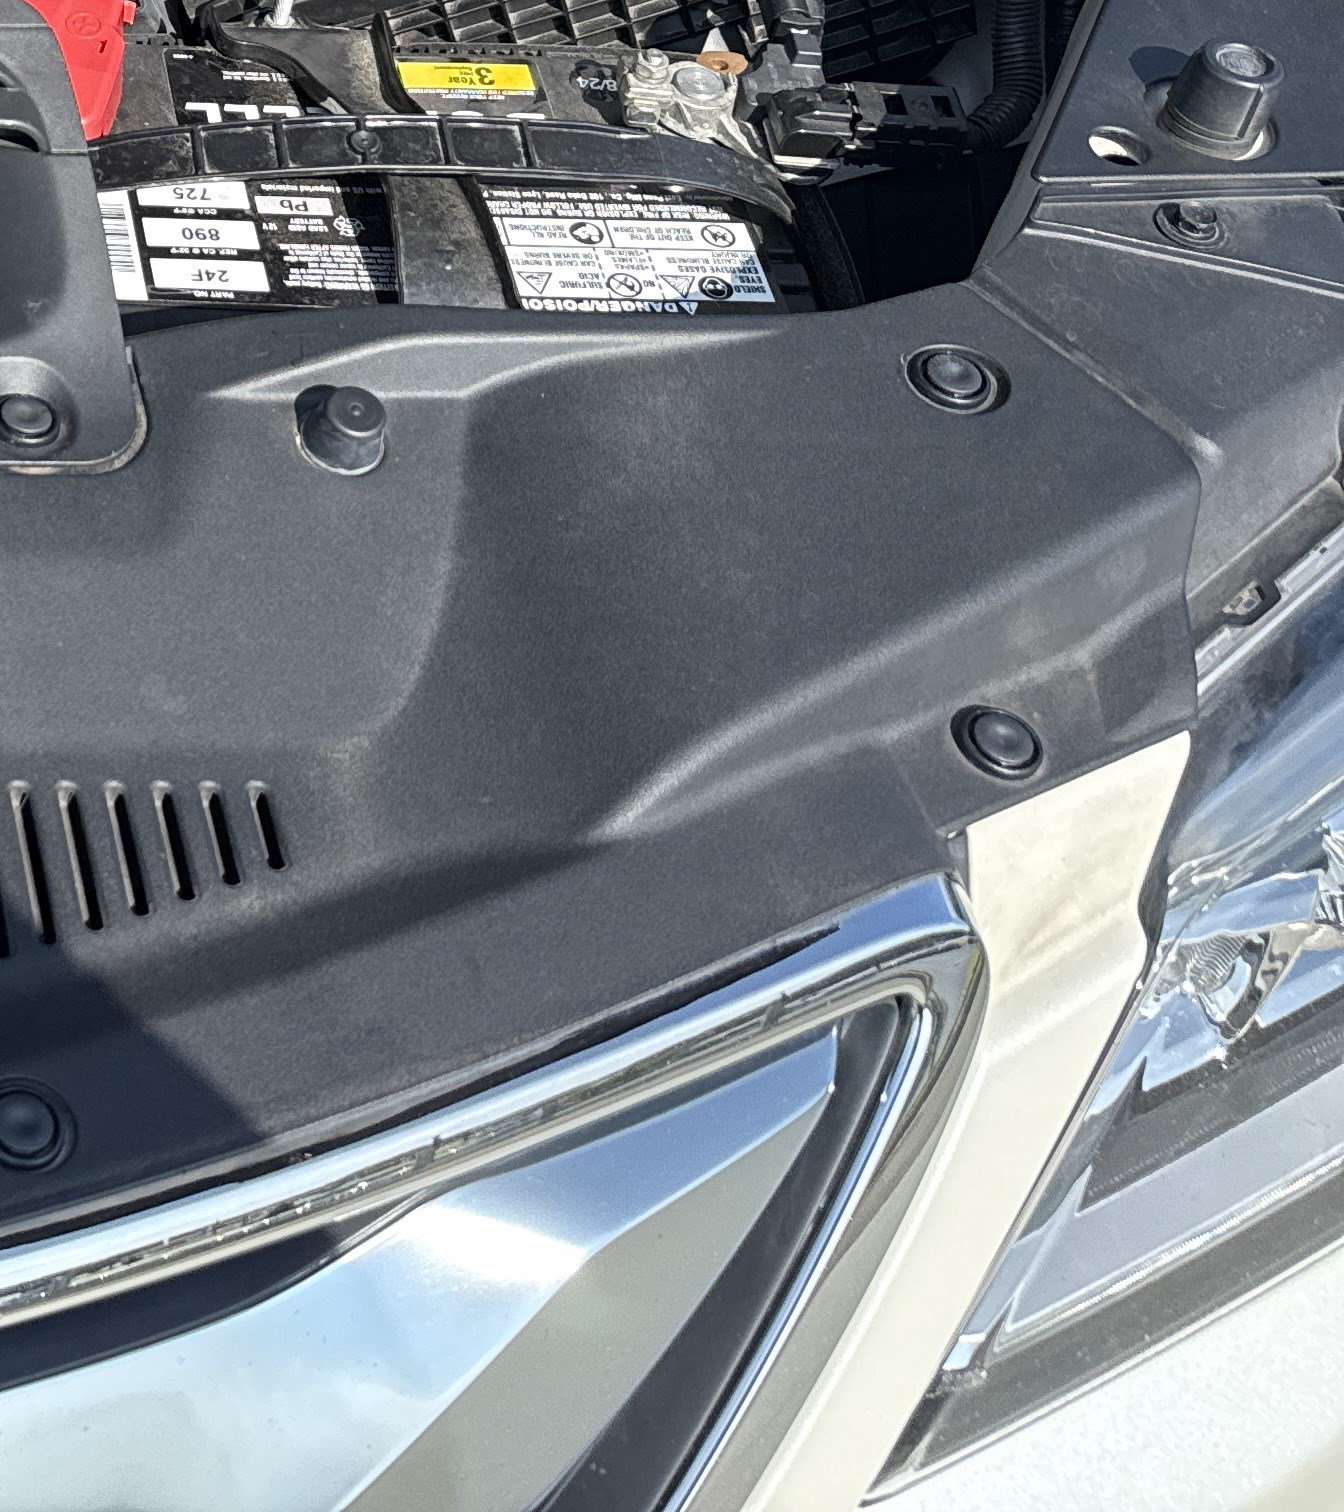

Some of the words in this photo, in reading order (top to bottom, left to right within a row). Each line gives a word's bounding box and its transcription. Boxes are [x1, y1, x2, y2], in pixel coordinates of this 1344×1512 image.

[448, 76, 476, 85] Year
[475, 67, 495, 85] 3
[576, 76, 618, 91] 8/24
[172, 187, 211, 201] 725
[279, 200, 308, 211] Pb
[182, 228, 220, 240] 890
[190, 269, 230, 283] 24F
[210, 290, 234, 298] PART
[520, 298, 678, 313] DANGER/POISO
